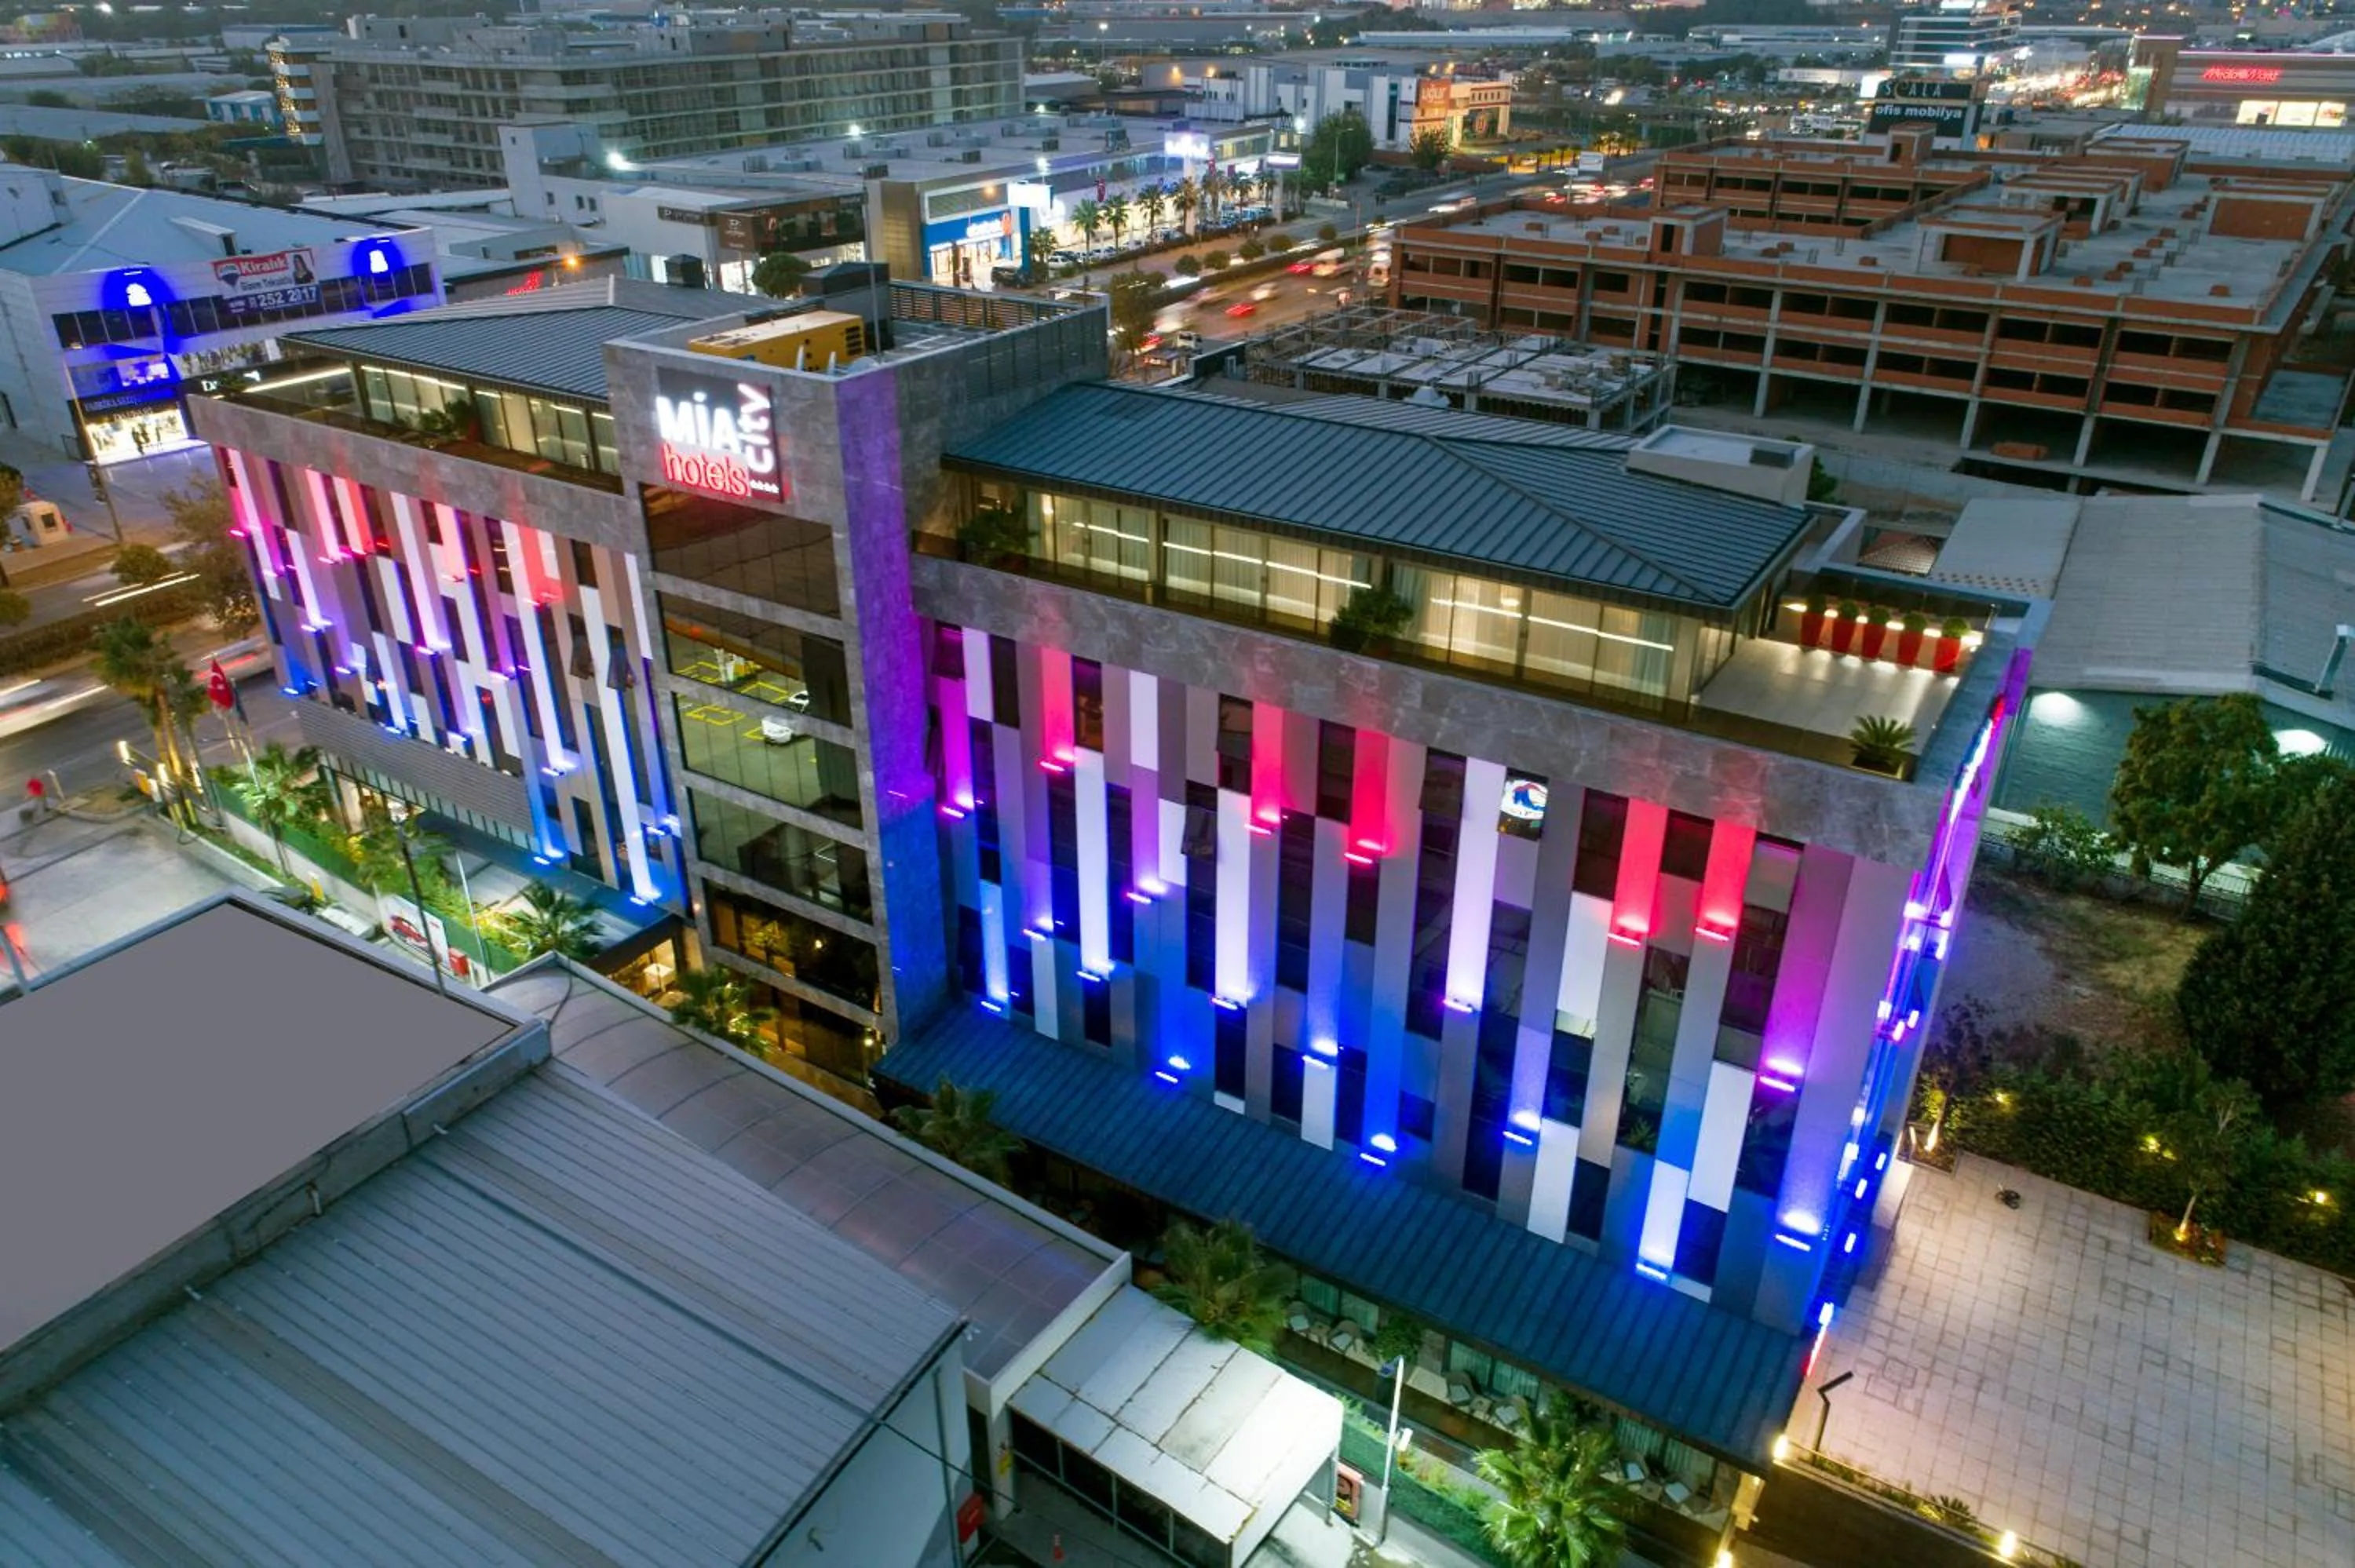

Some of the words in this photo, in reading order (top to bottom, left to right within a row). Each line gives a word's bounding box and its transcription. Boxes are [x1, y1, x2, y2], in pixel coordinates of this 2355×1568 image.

[1875, 104, 1901, 116] ofis
[1904, 106, 1962, 120] mobilya
[257, 291, 284, 308] 252
[662, 441, 750, 496] hotels
